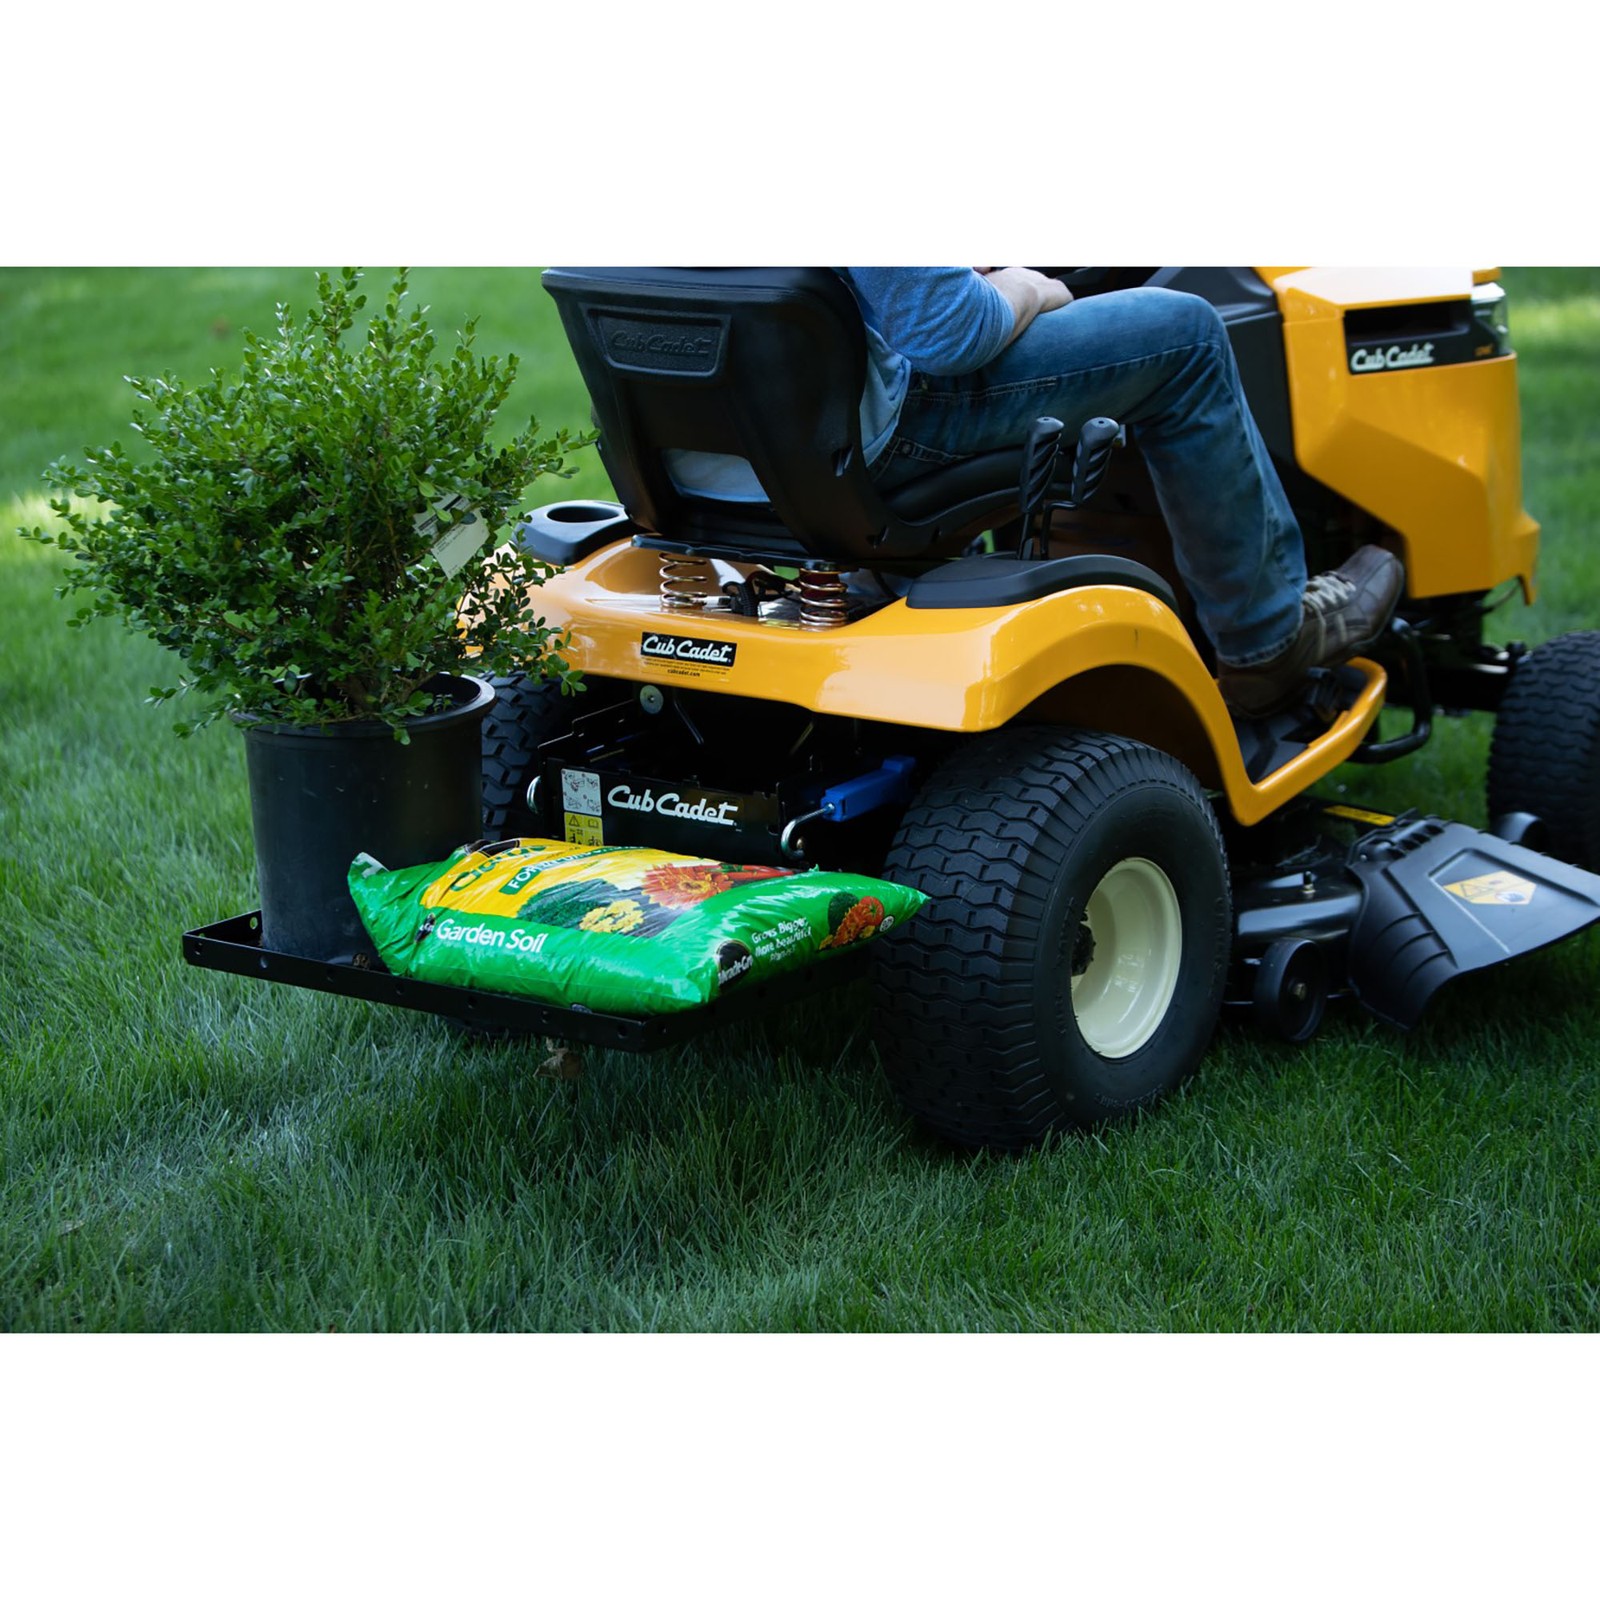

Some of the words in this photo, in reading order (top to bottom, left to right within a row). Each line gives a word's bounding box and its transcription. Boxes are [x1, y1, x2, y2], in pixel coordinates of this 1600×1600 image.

[645, 333, 713, 358] Cadet
[1351, 347, 1385, 372] Cub
[1385, 342, 1434, 368] Cadet
[642, 635, 675, 656] Cub
[675, 640, 733, 663] Cadet
[607, 784, 655, 813] Cub
[655, 792, 739, 827] Cadet
[436, 918, 506, 947] Garden
[506, 929, 548, 953] Soil
